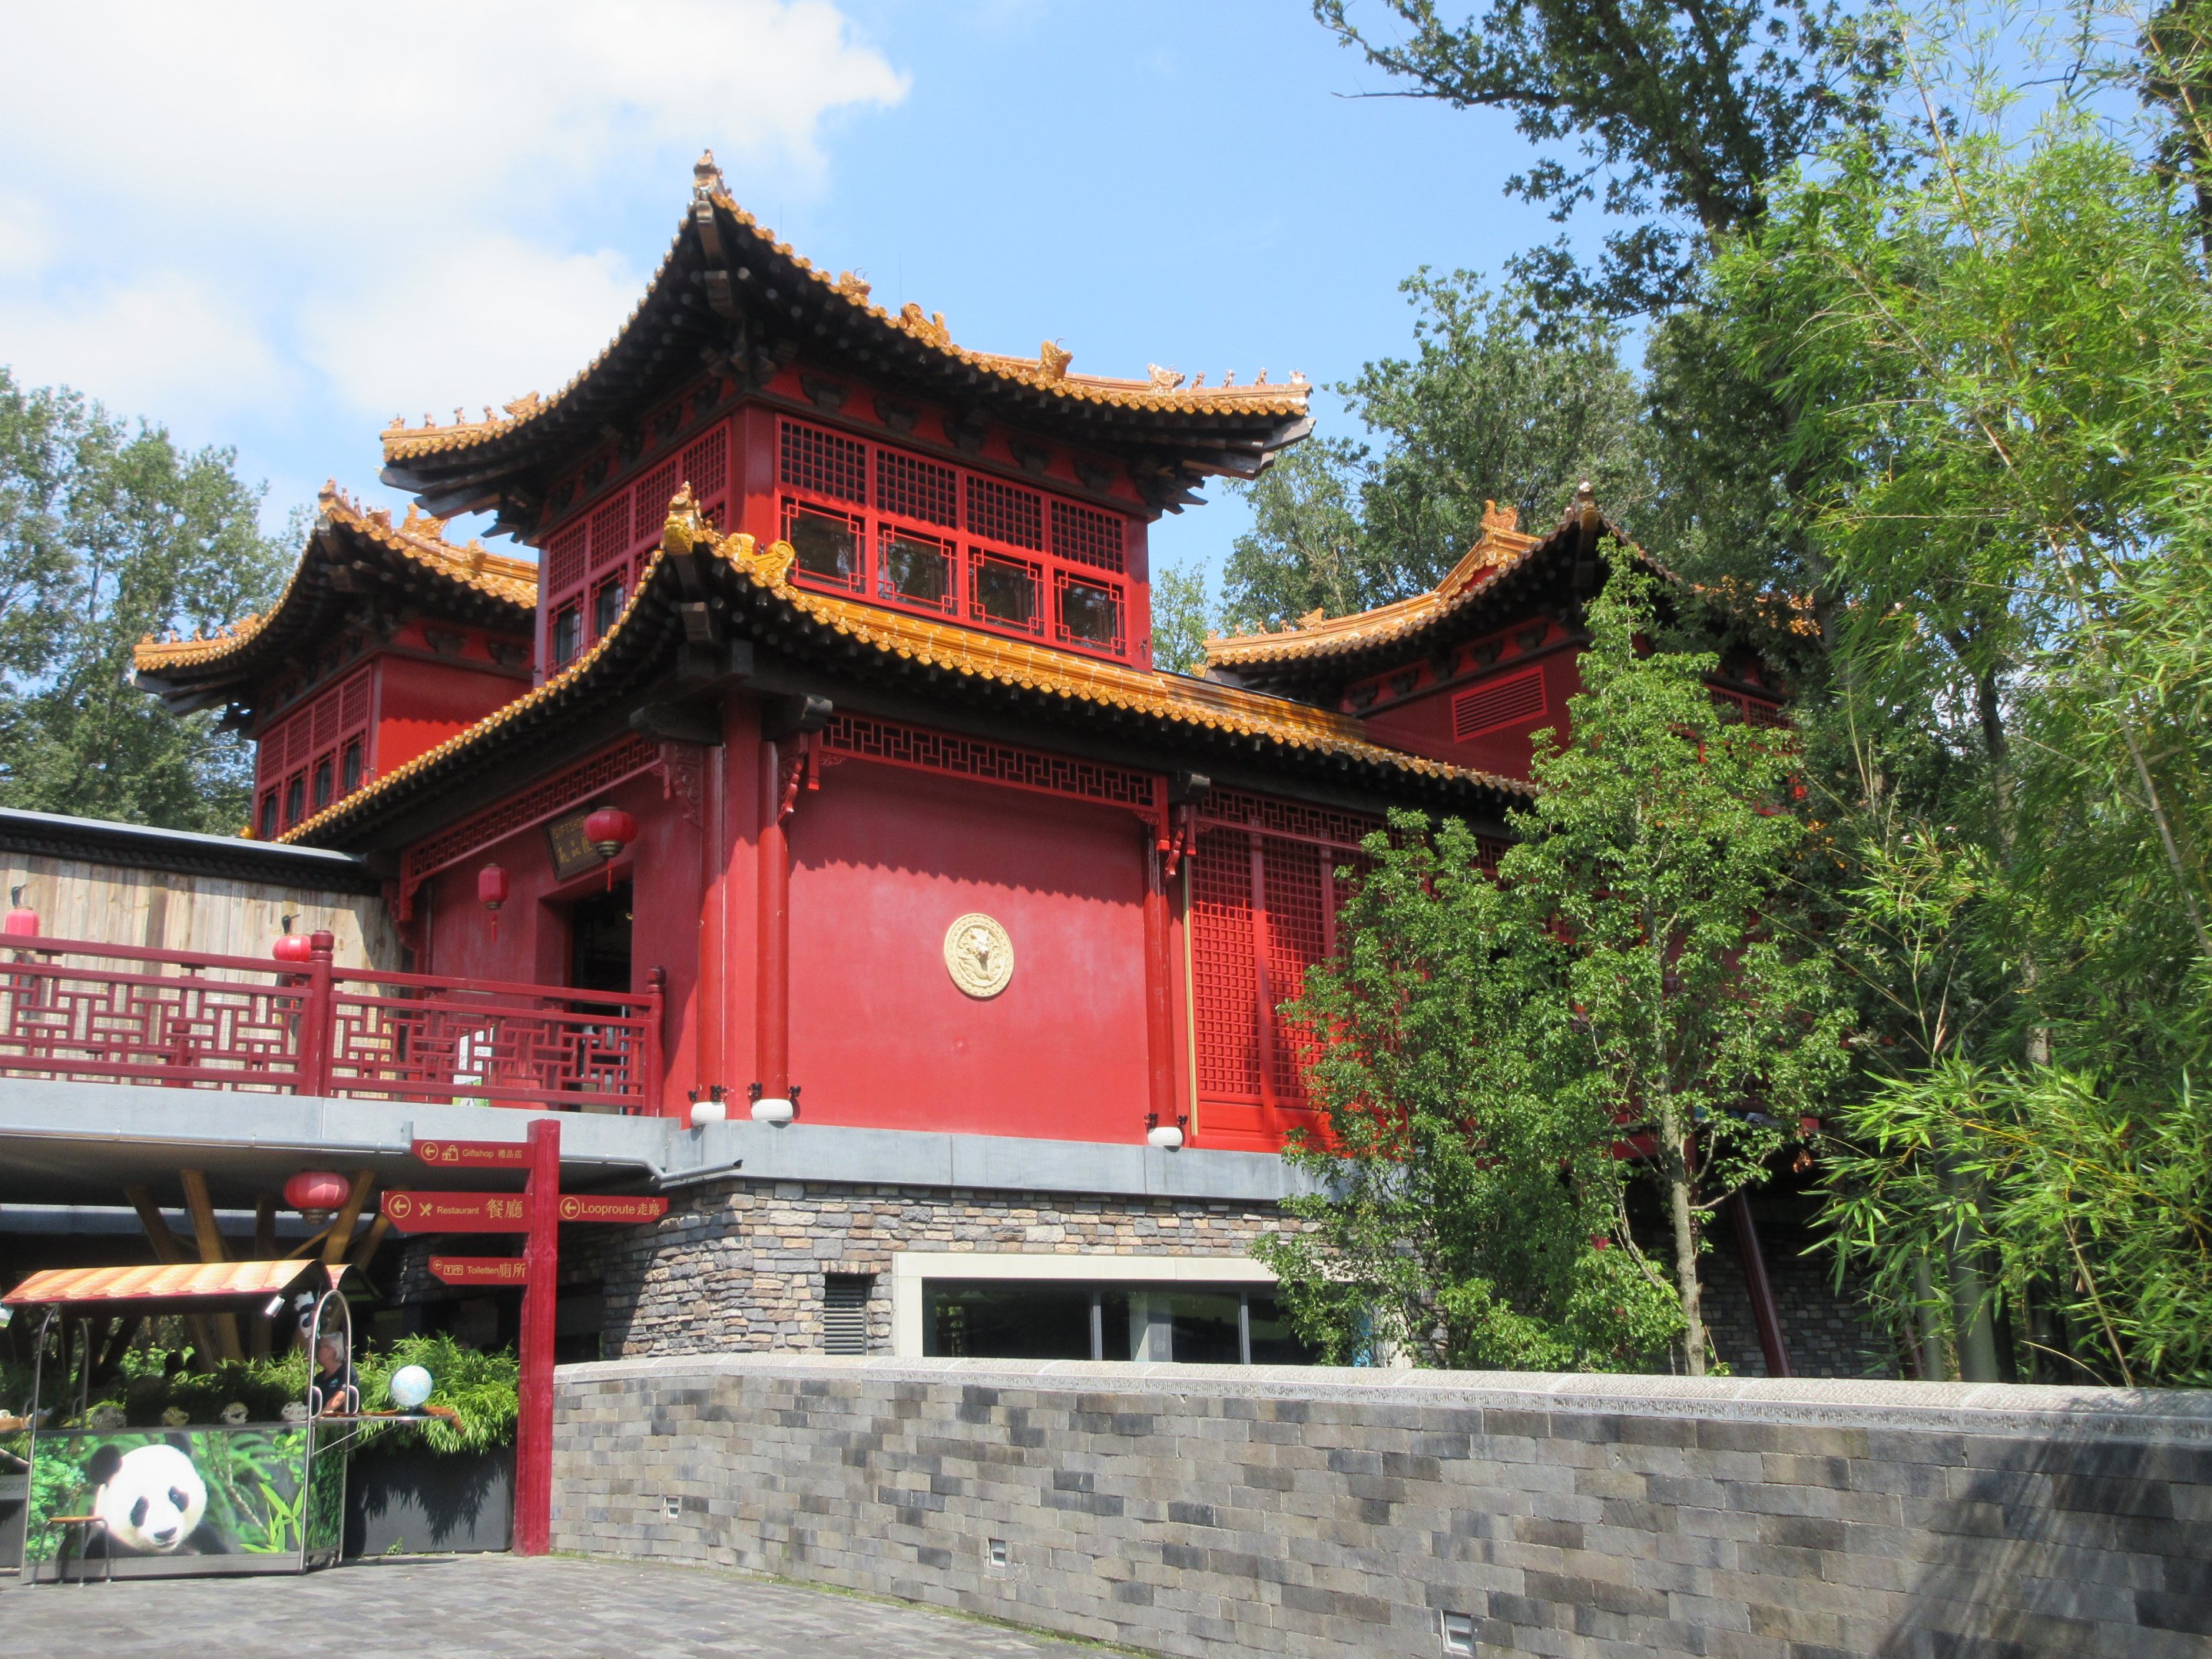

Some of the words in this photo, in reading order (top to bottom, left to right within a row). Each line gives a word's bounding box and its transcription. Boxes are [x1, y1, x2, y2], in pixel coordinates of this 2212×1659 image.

[462, 1149, 494, 1158] Giftshop
[498, 1149, 522, 1158] 禮品店
[436, 1206, 479, 1215] Restaurant
[485, 1198, 523, 1218] 餐廳
[581, 1202, 635, 1216] Looproute
[637, 1203, 661, 1216] 走路
[467, 1266, 499, 1274] Toiletten
[498, 1263, 527, 1278] 廁所
